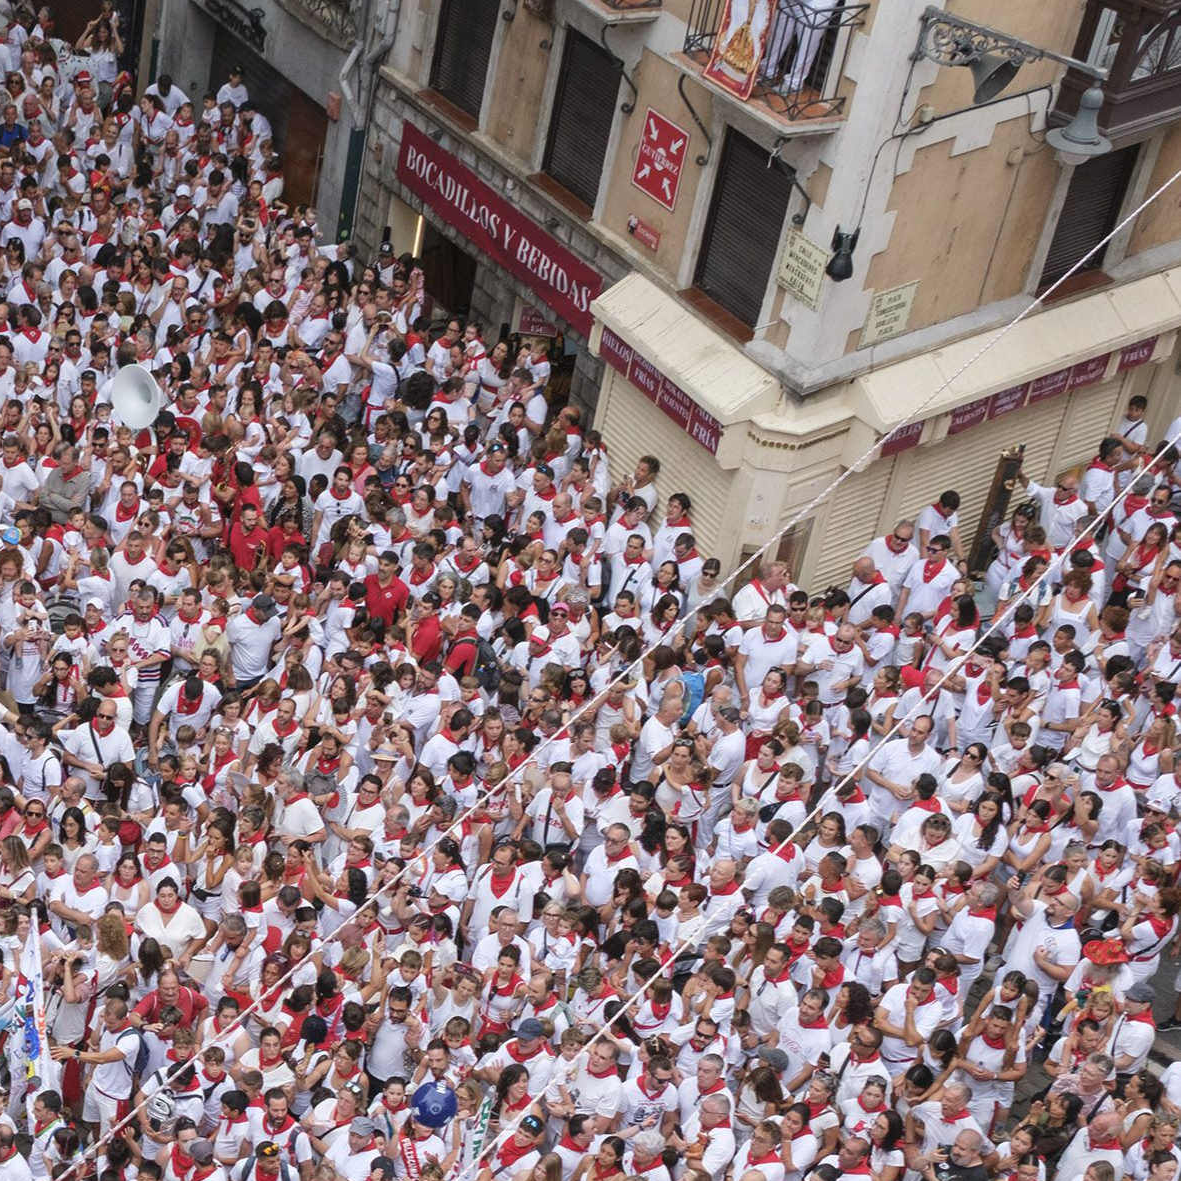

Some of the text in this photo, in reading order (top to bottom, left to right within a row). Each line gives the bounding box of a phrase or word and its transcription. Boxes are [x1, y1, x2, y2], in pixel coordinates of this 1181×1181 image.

[641, 143, 680, 176] GUTIERREZ
[406, 145, 591, 312] BOCADILLOS Y BEBIDAS
[788, 250, 818, 276] MERCADERES
[798, 245, 813, 260] CALLE
[602, 330, 631, 364] HIELOS
[692, 421, 716, 452] FRÍA
